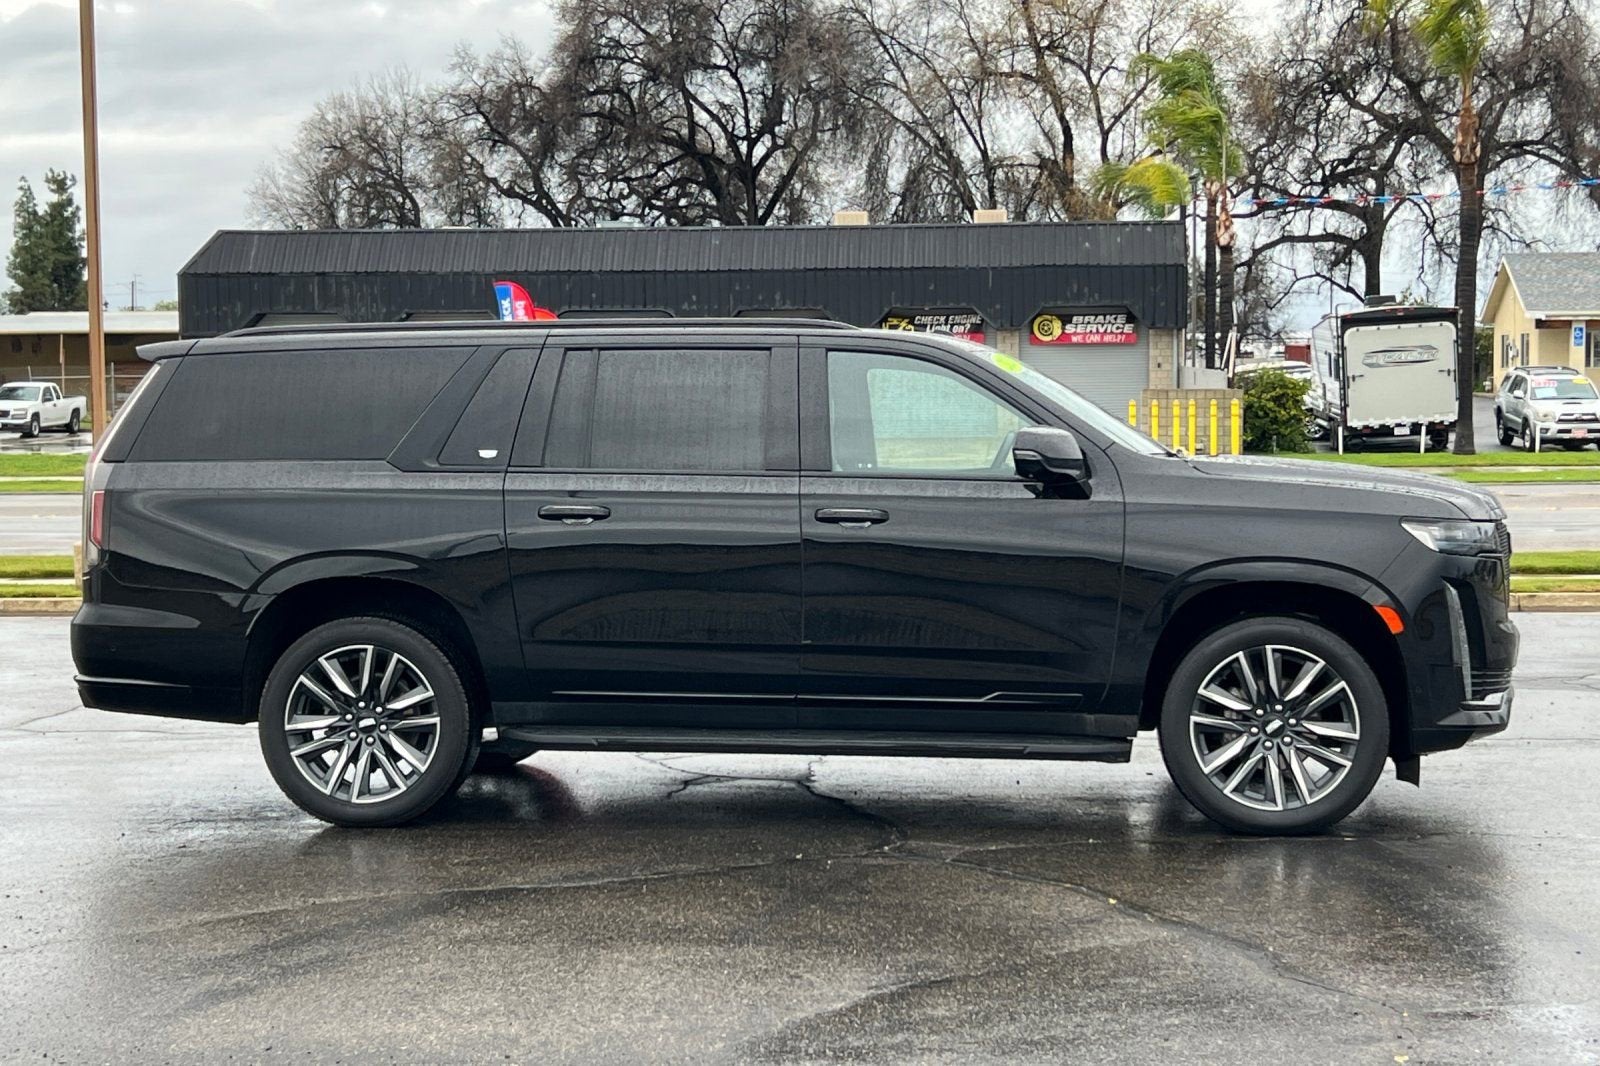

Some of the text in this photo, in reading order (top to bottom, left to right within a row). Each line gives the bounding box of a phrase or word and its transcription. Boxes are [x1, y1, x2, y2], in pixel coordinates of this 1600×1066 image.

[914, 314, 982, 324] CHECK ENGINE
[1071, 314, 1128, 324] BRAKE
[952, 323, 971, 334] on?
[1064, 323, 1135, 334] SERVICE
[1071, 334, 1083, 343] WE
[1085, 334, 1101, 343] CAN
